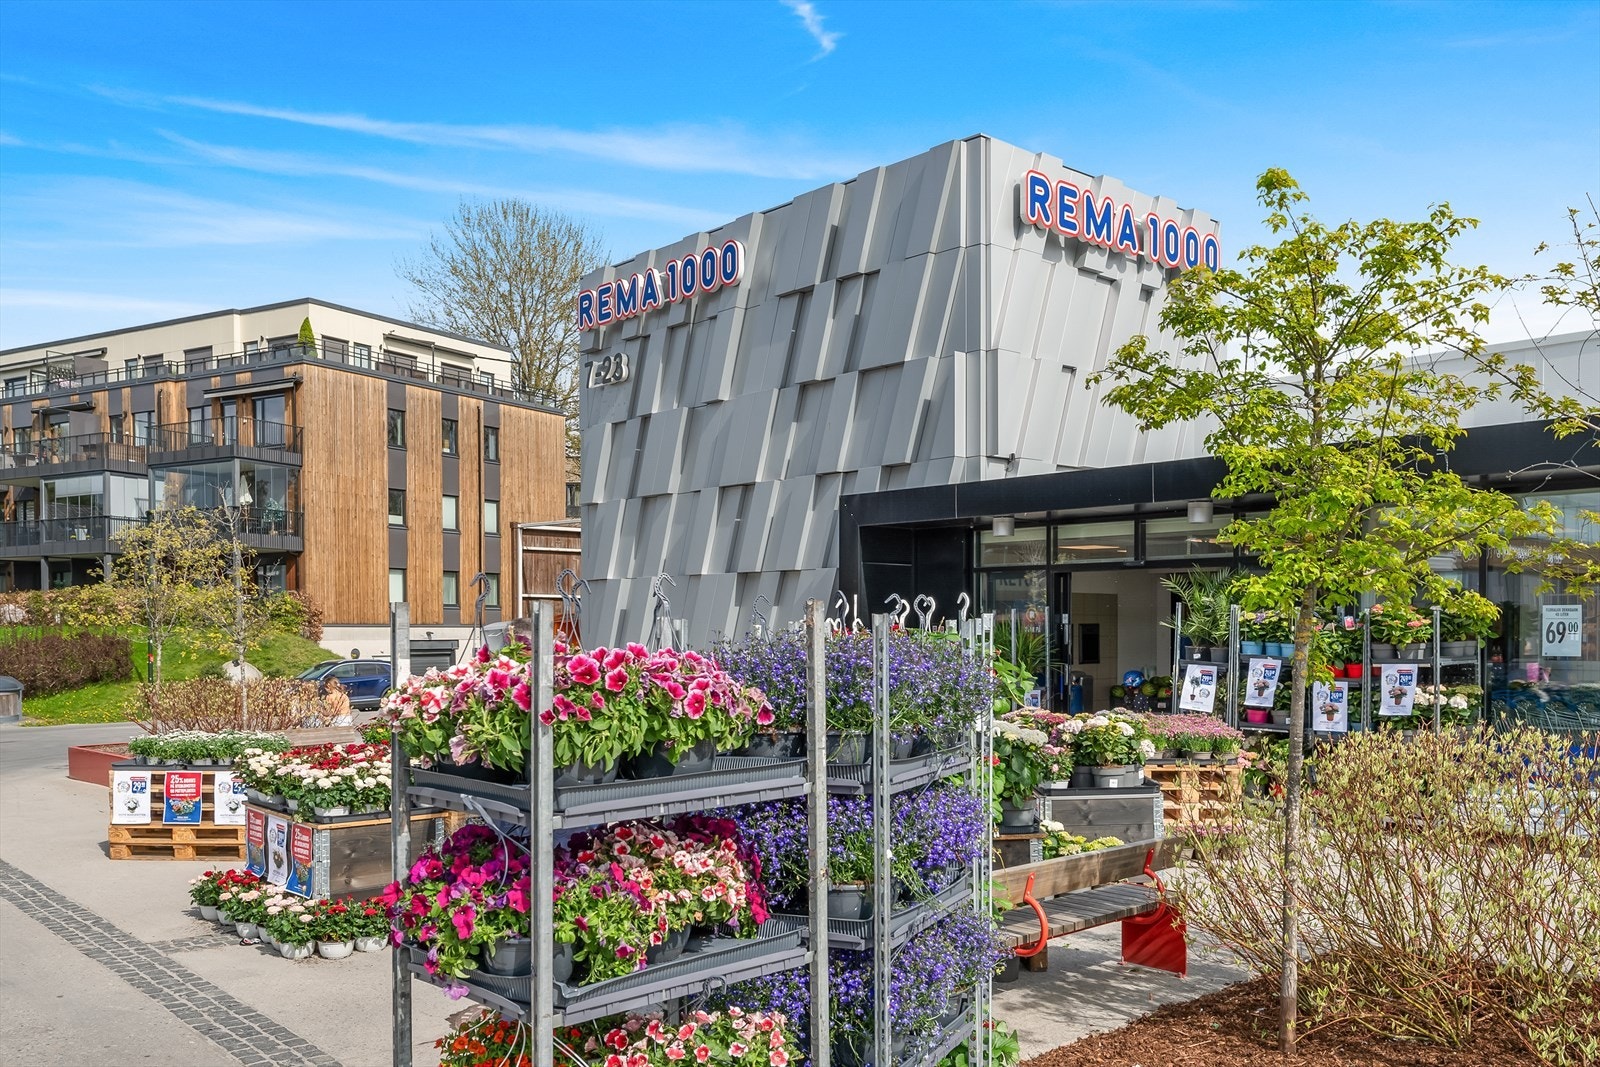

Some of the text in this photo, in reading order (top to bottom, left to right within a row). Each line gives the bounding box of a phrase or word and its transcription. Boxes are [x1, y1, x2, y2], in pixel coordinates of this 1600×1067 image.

[1026, 169, 1220, 274] REMA 1000
[577, 239, 739, 331] REMA 1000
[585, 352, 625, 388] 7-23
[1546, 621, 1579, 644] 69 00
[170, 774, 184, 783] 25%
